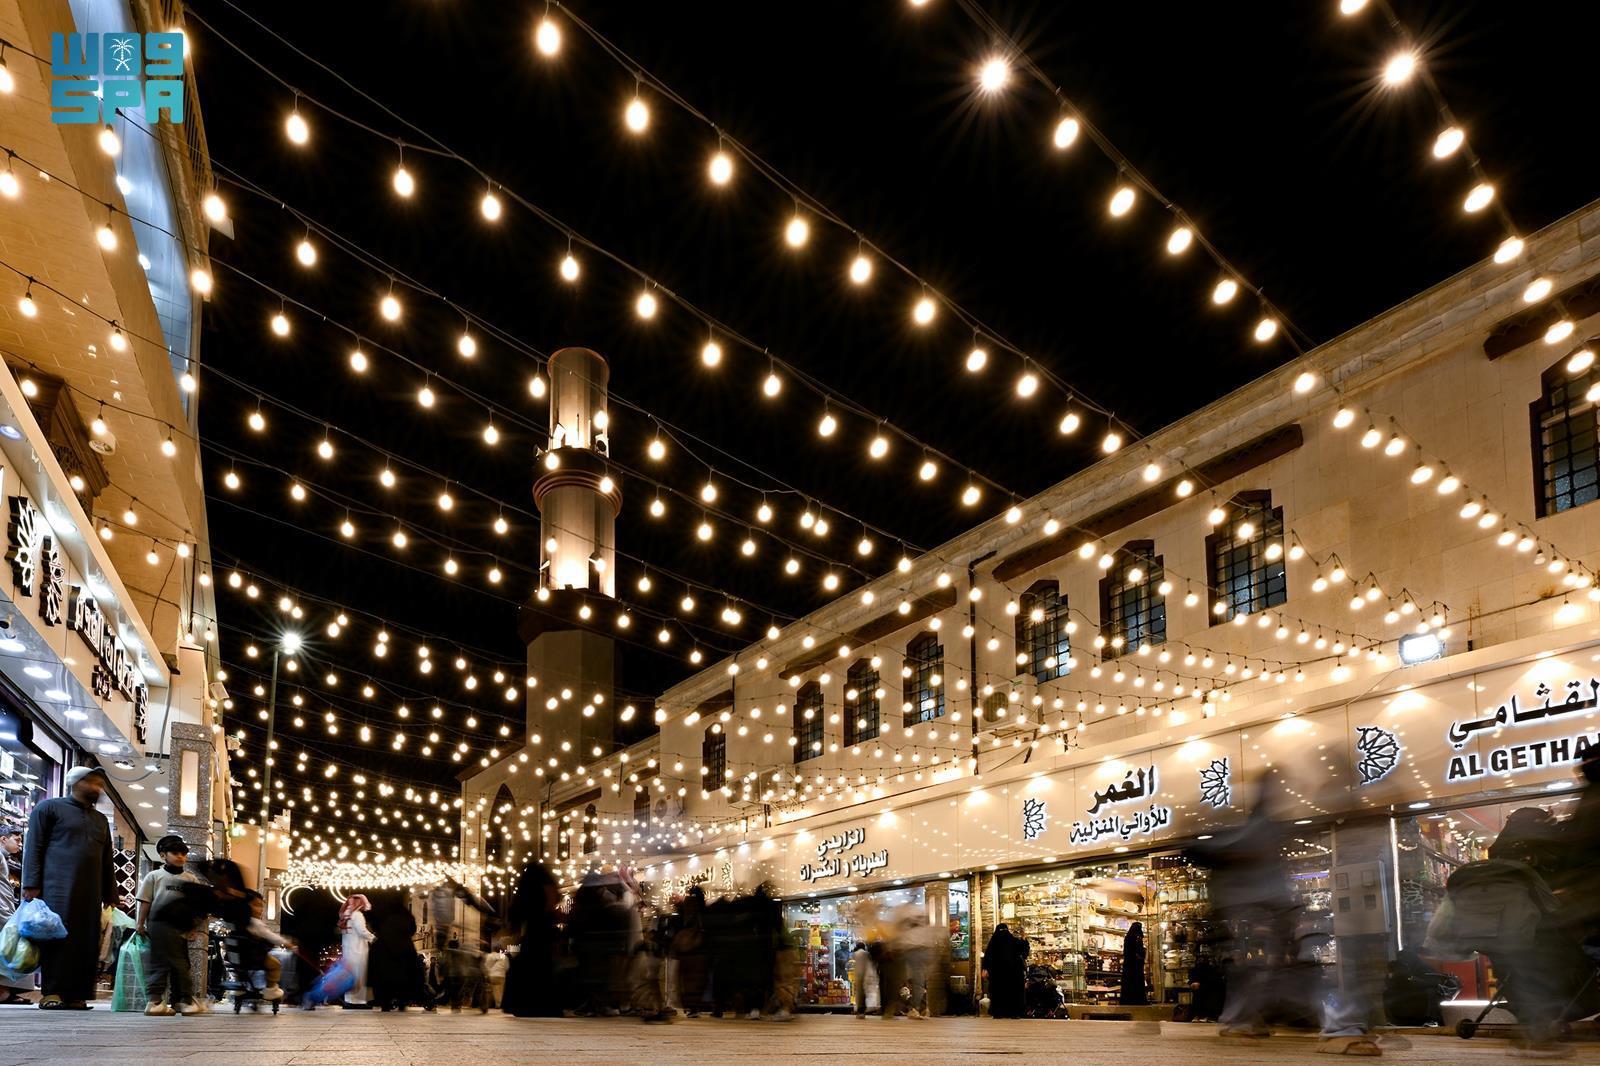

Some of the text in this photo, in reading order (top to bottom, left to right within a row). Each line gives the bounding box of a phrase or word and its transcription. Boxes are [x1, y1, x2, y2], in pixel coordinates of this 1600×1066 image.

[1491, 733, 1600, 772] GETHA
[1069, 804, 1168, 843] للأواني المنزلية
